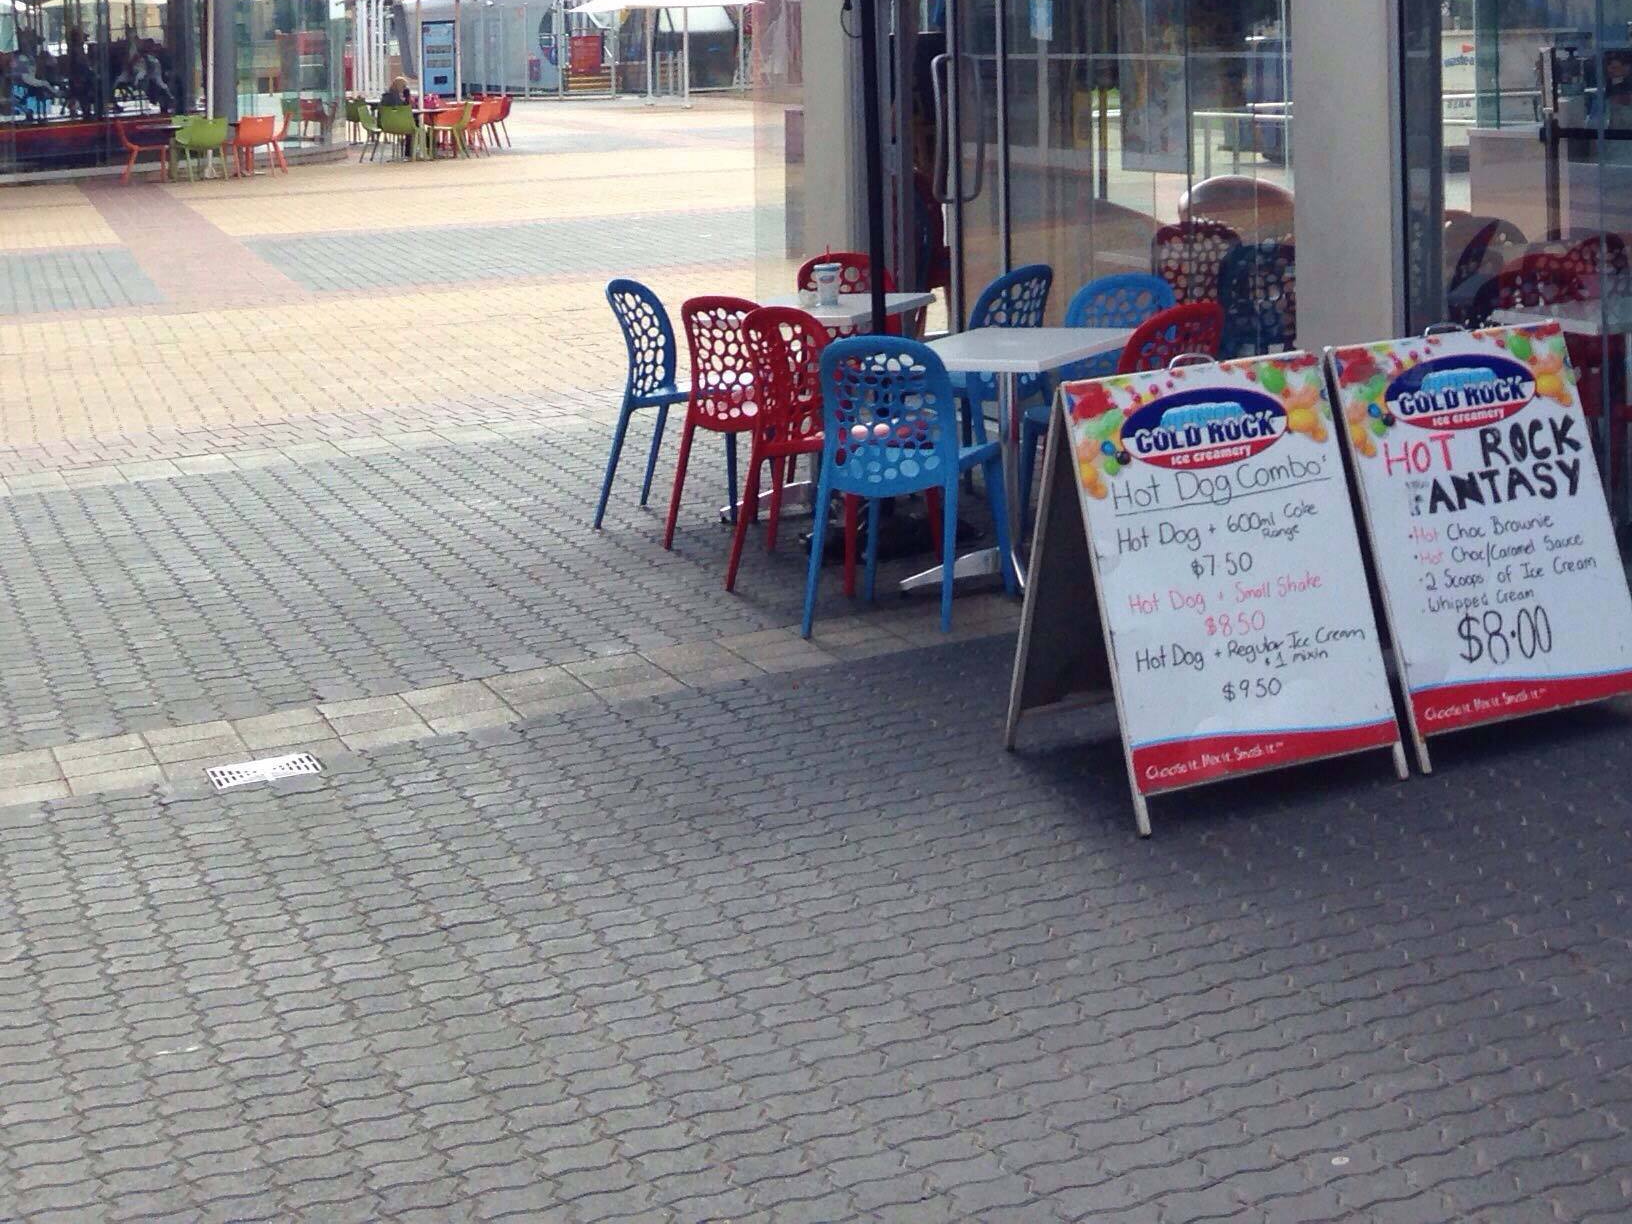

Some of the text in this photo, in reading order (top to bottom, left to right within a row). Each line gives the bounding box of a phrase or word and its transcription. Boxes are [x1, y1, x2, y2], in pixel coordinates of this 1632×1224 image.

[1398, 375, 1527, 416] COLD ROCK
[1134, 410, 1276, 454] COLD ROCK
[1382, 413, 1583, 477] HOT ROCK
[1193, 445, 1252, 463] creamery
[1111, 473, 1161, 510] Hot
[1174, 470, 1232, 506] Dog
[1117, 525, 1150, 554] Hot
[1159, 521, 1202, 552] Dog
[1227, 511, 1276, 533] 600ml
[1283, 499, 1319, 518] Coke
[1446, 522, 1486, 542] Choc
[1490, 513, 1555, 537] Brownie
[1128, 592, 1159, 615] Hot
[1168, 589, 1206, 616] Dog
[1235, 580, 1271, 604] Small
[1277, 571, 1323, 598] Shake
[1425, 571, 1438, 591] 2
[1496, 565, 1513, 584] of
[1552, 555, 1598, 575] Cream
[1495, 588, 1536, 606] Cream
[1135, 644, 1167, 673] Hot
[1171, 642, 1205, 671] Dog
[1315, 626, 1366, 644] Cream
[1457, 604, 1553, 665] $8.00
